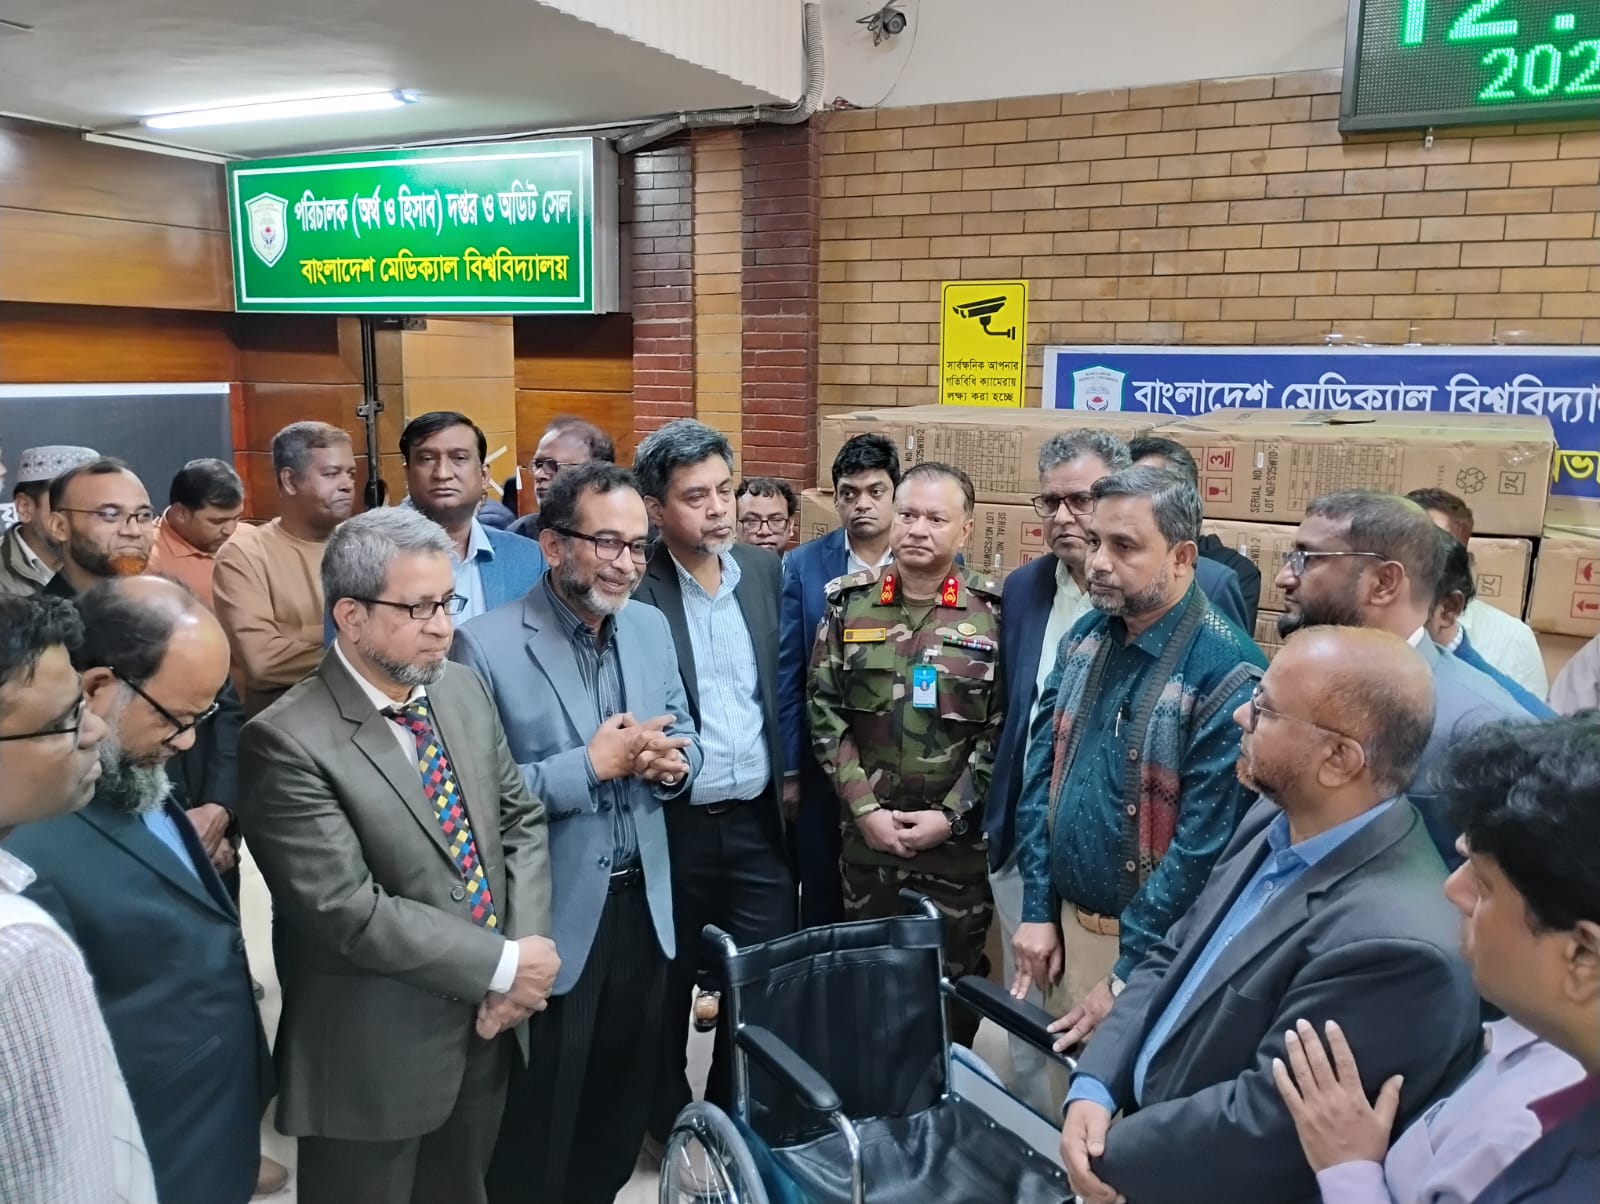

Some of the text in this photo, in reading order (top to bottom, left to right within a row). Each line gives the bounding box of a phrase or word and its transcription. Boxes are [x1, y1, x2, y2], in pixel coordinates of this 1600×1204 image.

[294, 189, 349, 231] পরিচালক
[384, 197, 396, 226] ও
[445, 189, 478, 227] দপ্তর
[482, 194, 495, 223] ও
[497, 179, 539, 225] অডিট
[542, 190, 572, 224] সেল
[299, 247, 570, 285] বাংলাদেশ মেডিক্যাল বিশ্ববিদ্যালয়
[987, 360, 1019, 370] আপনার
[970, 392, 989, 401] করা
[1132, 371, 1600, 423] বাংলাদেশ মেডিক্যাল বিশ্ববিদ্যা
[1250, 484, 1262, 513] SERIAL
[1264, 499, 1275, 513] LOT
[986, 512, 995, 525] LOT
[997, 512, 1007, 536] SERIAL
